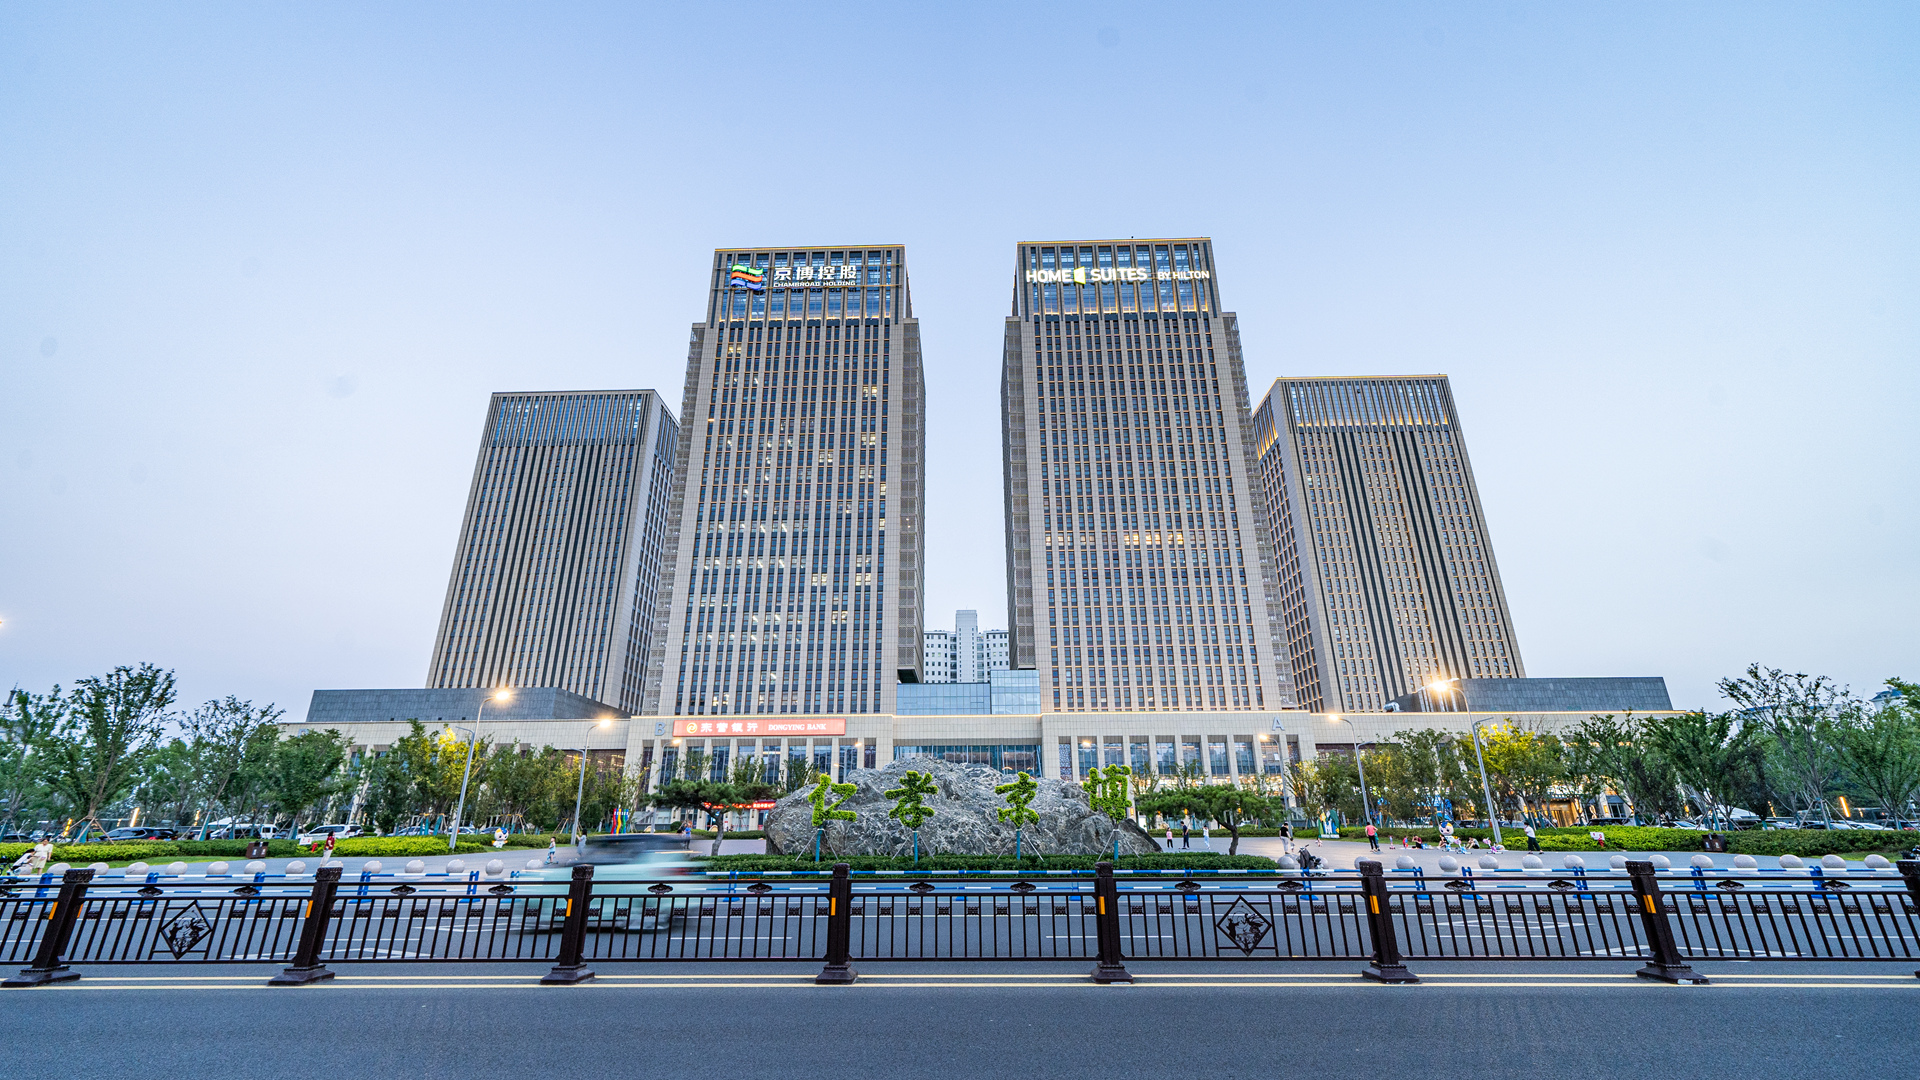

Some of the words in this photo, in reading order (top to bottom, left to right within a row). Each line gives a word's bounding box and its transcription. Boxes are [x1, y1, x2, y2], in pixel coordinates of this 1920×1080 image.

[774, 265, 857, 281] 京博控股
[1090, 268, 1148, 281] SUITES
[1157, 271, 1171, 280] BY
[1172, 270, 1210, 280] HILTON
[654, 721, 666, 736] B
[767, 723, 806, 731] DONGYING
[806, 722, 827, 731] BANK
[1271, 716, 1286, 731] A
